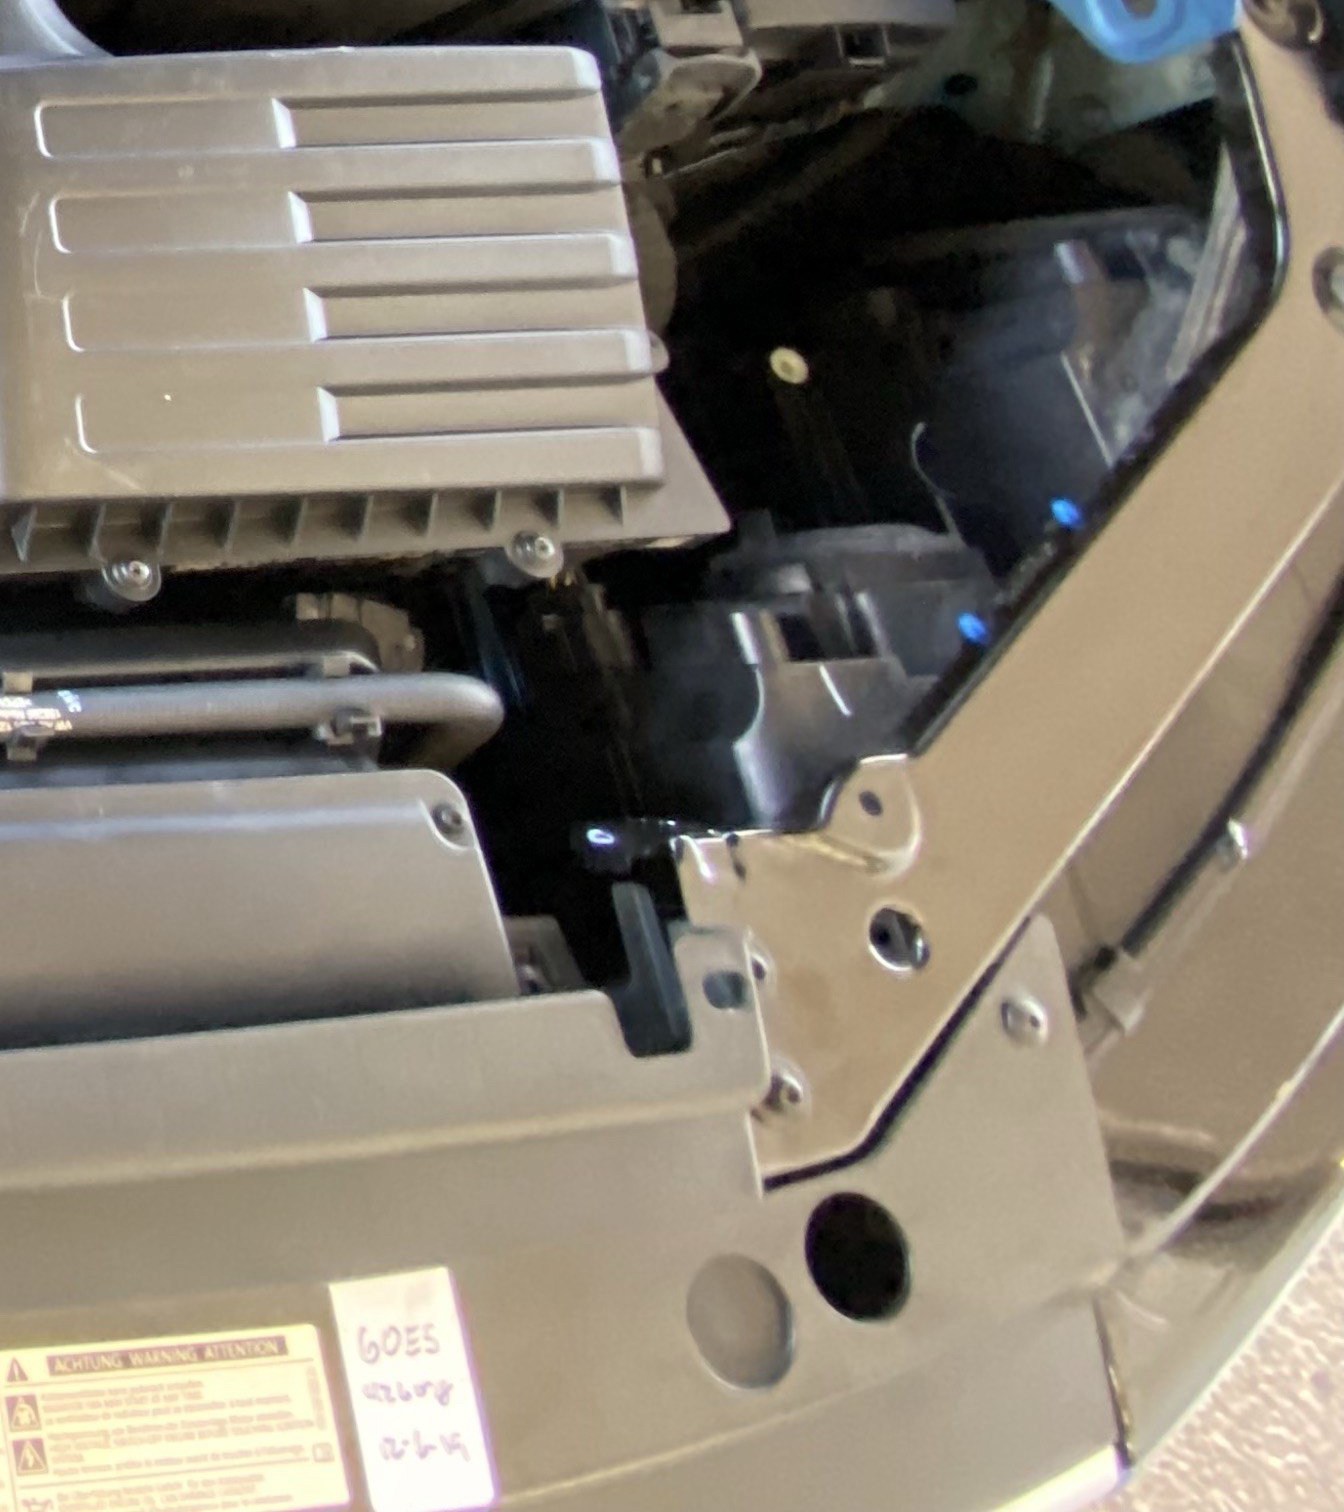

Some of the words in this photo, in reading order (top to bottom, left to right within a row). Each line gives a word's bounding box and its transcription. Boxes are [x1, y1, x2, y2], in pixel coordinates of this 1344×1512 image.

[53, 1353, 124, 1373] ACHTUNG
[128, 1346, 198, 1367] WARNING
[203, 1339, 281, 1360] ATTENTION
